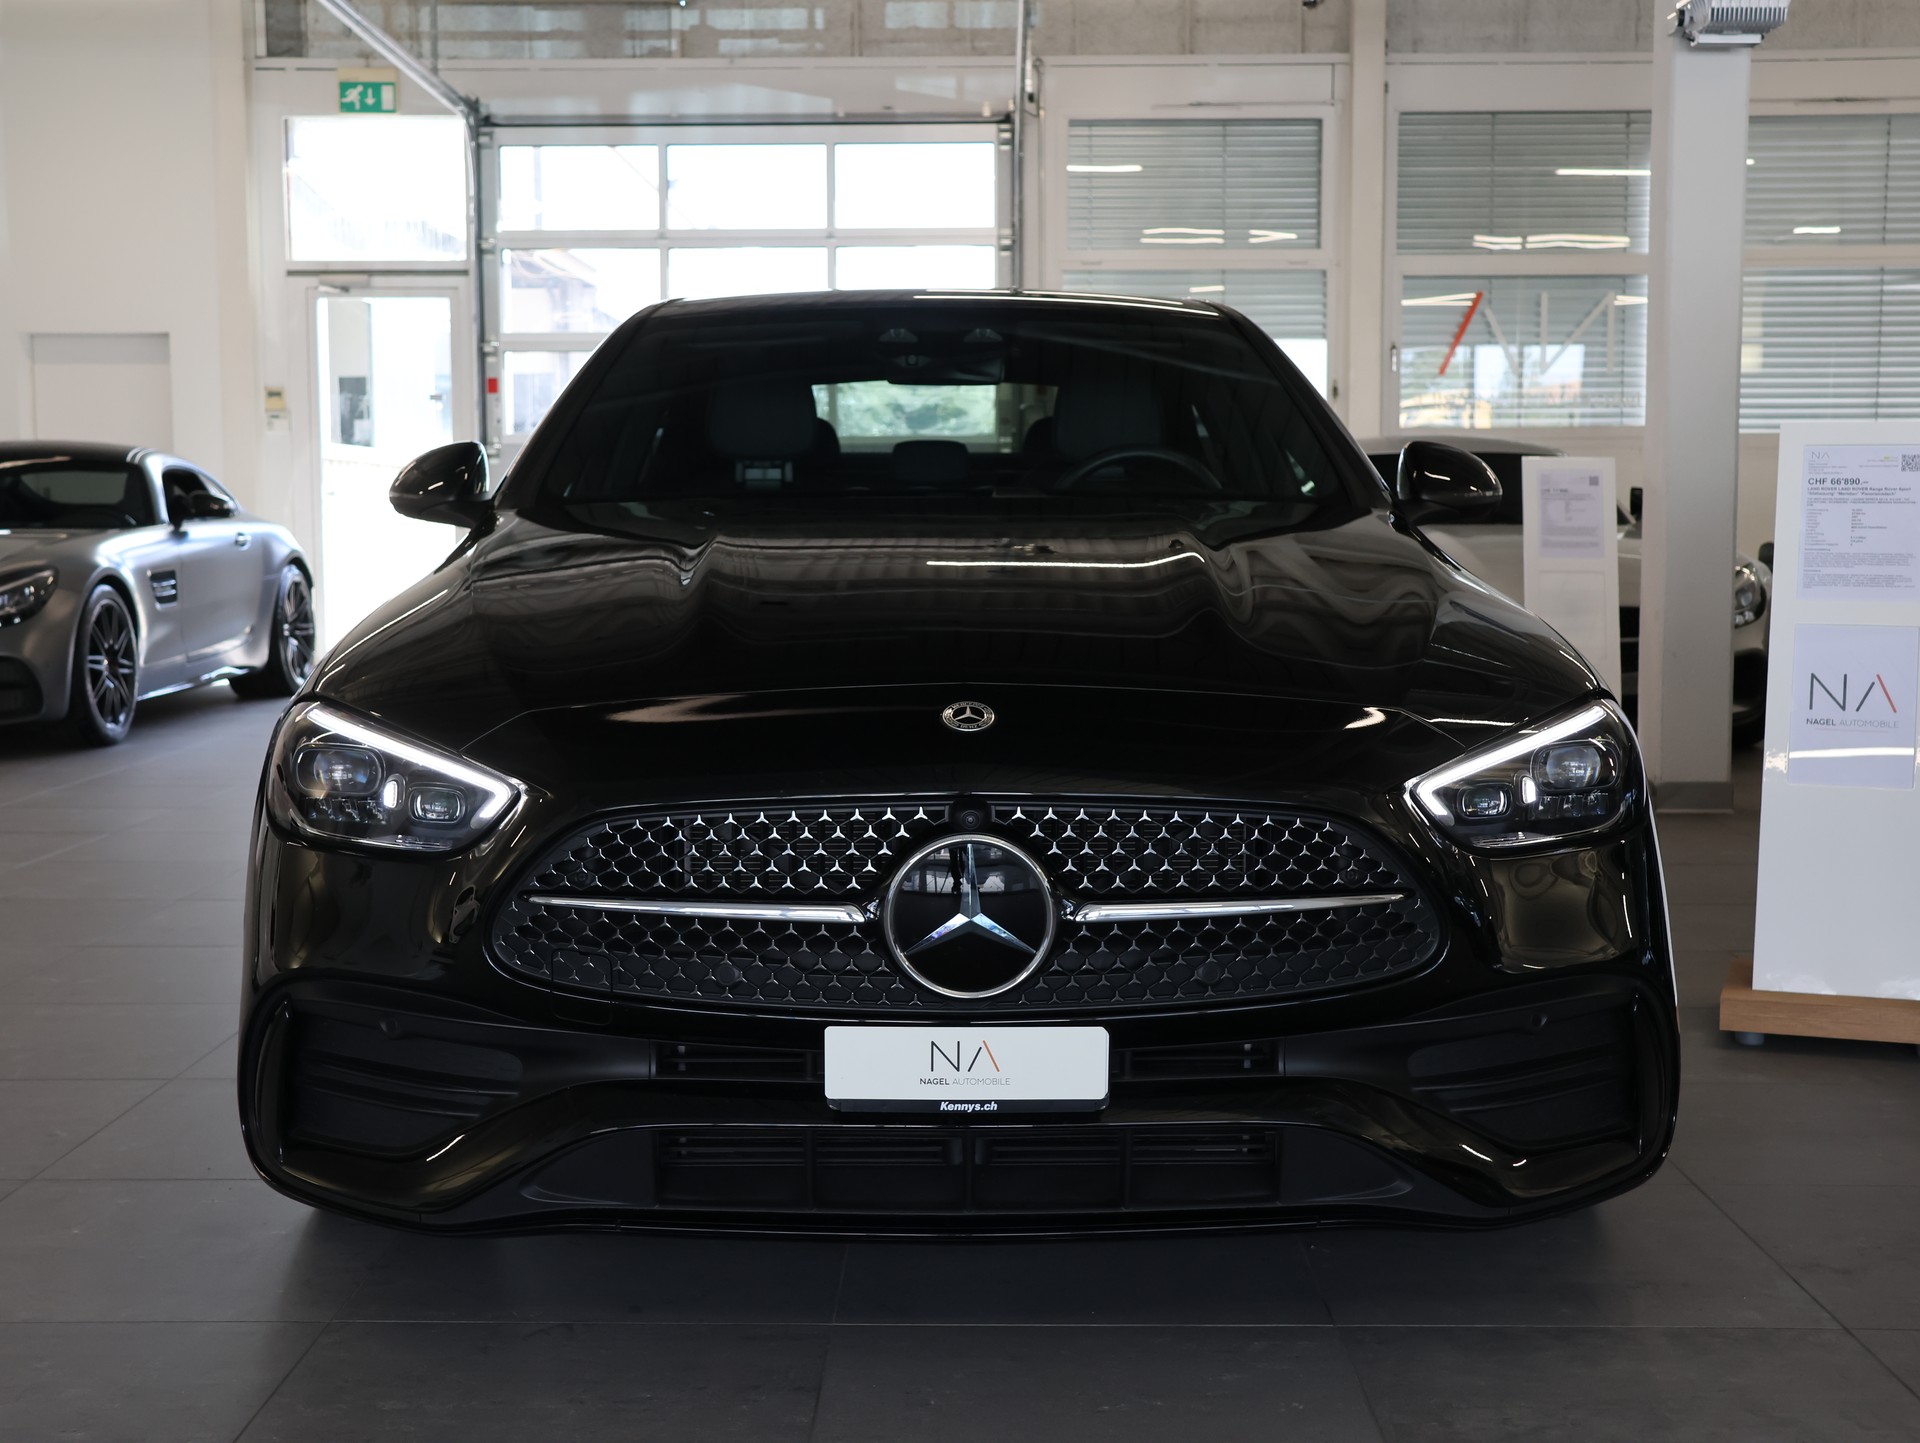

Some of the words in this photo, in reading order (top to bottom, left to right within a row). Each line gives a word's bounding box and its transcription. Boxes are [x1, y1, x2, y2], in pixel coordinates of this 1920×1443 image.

[1808, 477, 1828, 486] CHF
[1809, 672, 1897, 713] NA
[1806, 718, 1837, 726] NAGEL
[1839, 719, 1899, 728] AUTOMOBILE
[930, 1040, 1000, 1072] NA
[919, 1077, 950, 1086] NAGEL
[952, 1077, 1011, 1086] AUTOMOBILE
[940, 1101, 998, 1112] Kennys.ch
